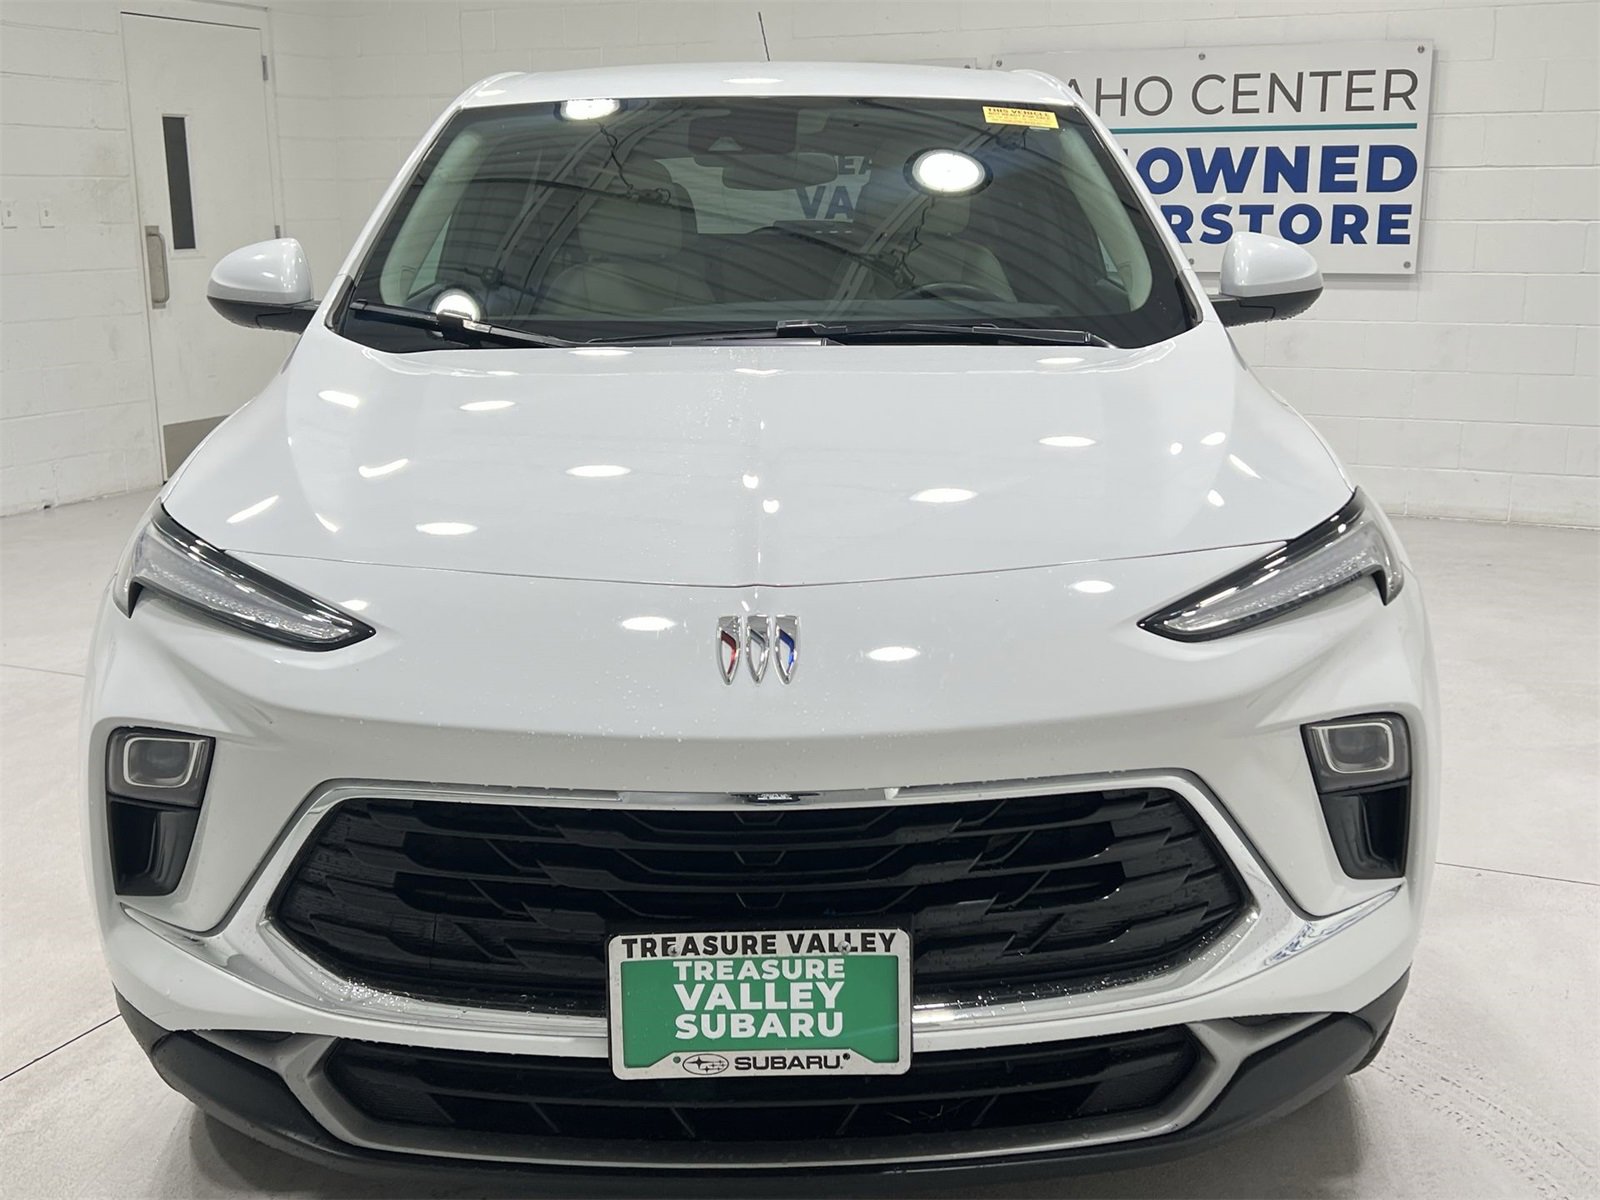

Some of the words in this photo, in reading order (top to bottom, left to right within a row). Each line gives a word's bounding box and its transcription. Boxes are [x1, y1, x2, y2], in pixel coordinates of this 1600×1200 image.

[1192, 69, 1418, 115] CENTER
[1125, 144, 1418, 194] OWNED
[622, 934, 777, 958] TREASURE
[787, 932, 896, 954] VALLEY
[673, 958, 845, 982] TREASURE
[673, 981, 845, 1011] VALLEY
[675, 1011, 844, 1040] SUBARU
[734, 1055, 840, 1070] SUBARU
